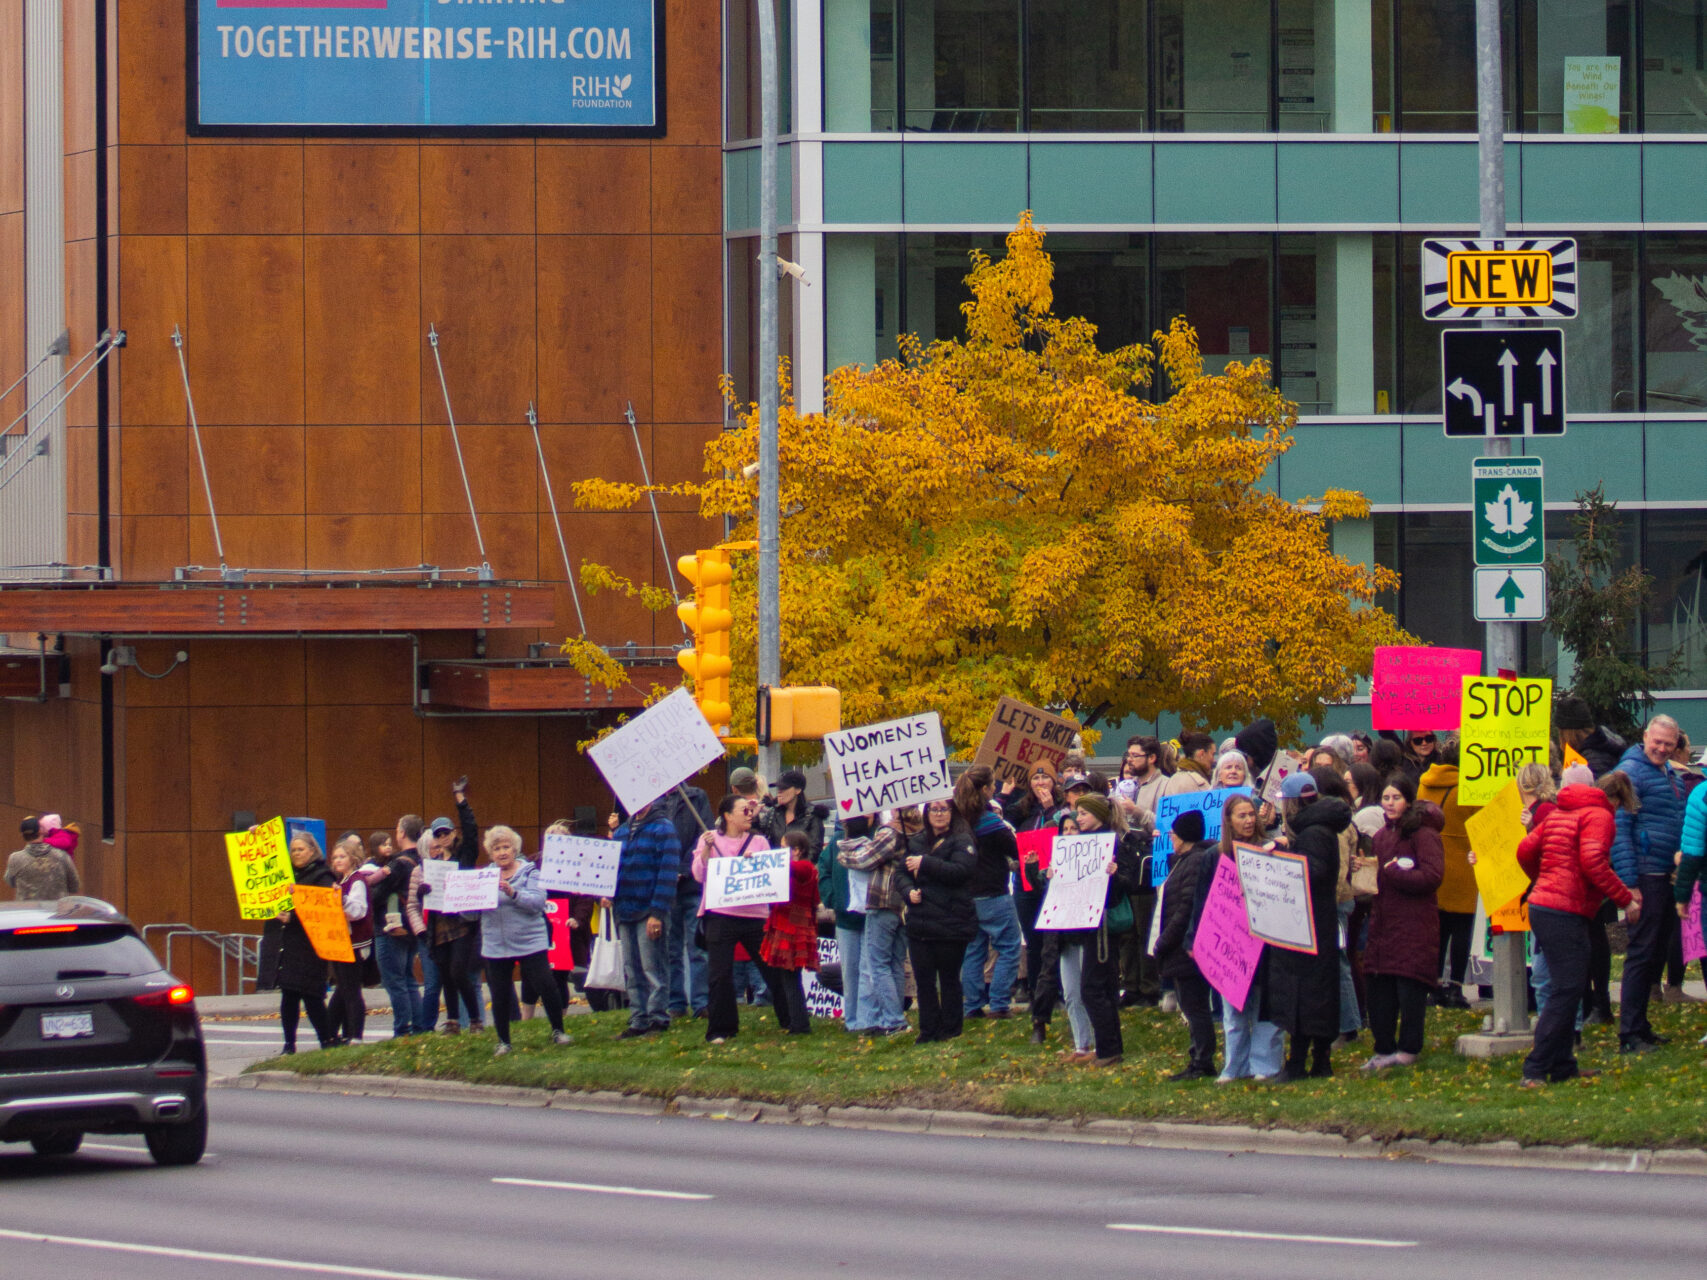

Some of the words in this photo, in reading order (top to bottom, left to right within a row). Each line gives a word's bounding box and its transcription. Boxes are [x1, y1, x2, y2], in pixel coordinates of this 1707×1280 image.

[218, 25, 631, 60] TOGETHERWERISE-RIH.COM
[1567, 63, 1581, 71] You
[1604, 63, 1618, 71] the
[1582, 72, 1602, 80] Wind
[573, 76, 610, 97] RIH
[1566, 82, 1599, 91] Beneath
[1603, 82, 1618, 90] Our
[572, 98, 632, 109] FOUNDATION
[1458, 258, 1541, 300] NEW
[1477, 467, 1539, 477] TRANS-CANADA
[1503, 497, 1512, 526] 1
[1390, 703, 1414, 716] FOR
[1418, 703, 1446, 715] THEM
[1468, 682, 1543, 720] STOP
[635, 698, 694, 745] FUTURE
[828, 716, 928, 757] WOMEN'S
[995, 731, 1011, 755] A
[1041, 720, 1077, 749] BIRTH
[842, 746, 933, 787] HEALTH
[1465, 742, 1543, 781] START
[856, 759, 949, 812] MATTERS!
[1161, 798, 1179, 817] Eby
[239, 844, 277, 862] HEALTH
[716, 861, 721, 876] I
[730, 851, 786, 876] DESERVE
[1056, 835, 1099, 871] Support
[1077, 847, 1101, 880] Local
[247, 863, 258, 876] IS
[264, 855, 279, 872] NOT
[246, 869, 289, 890] OPTIONAL
[724, 873, 772, 895] BETTER
[807, 991, 842, 1007] MAMA
